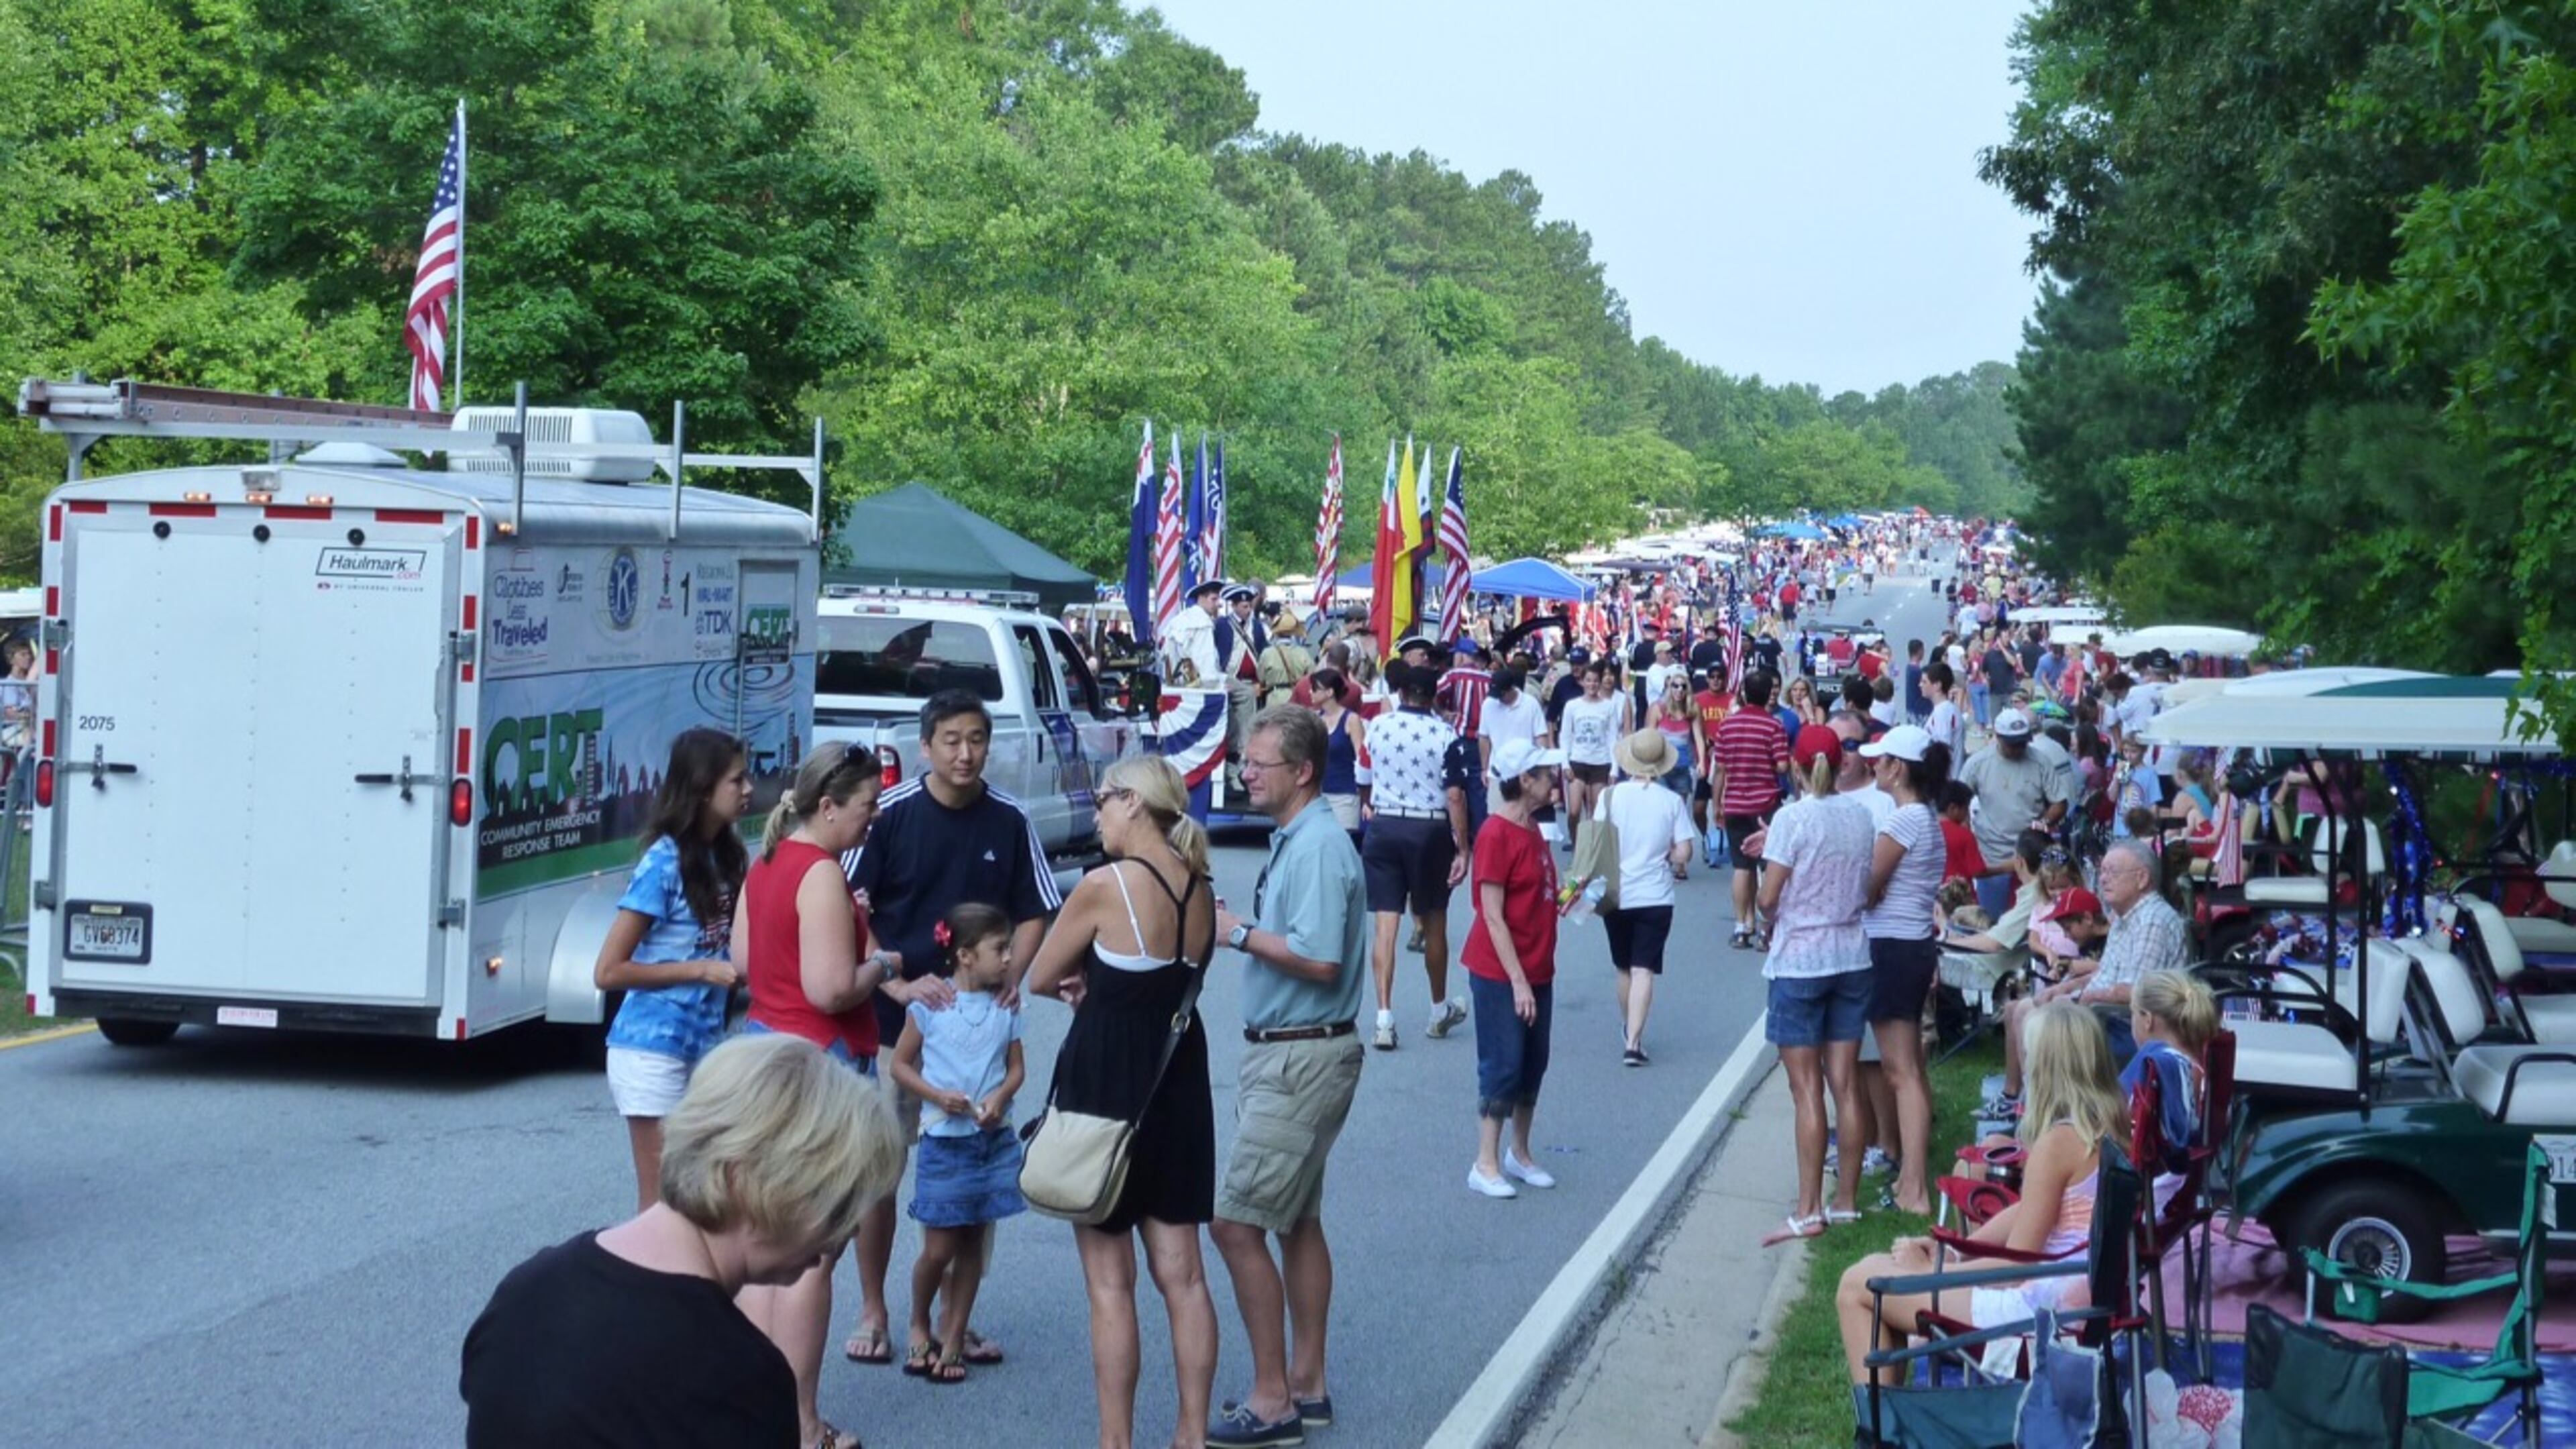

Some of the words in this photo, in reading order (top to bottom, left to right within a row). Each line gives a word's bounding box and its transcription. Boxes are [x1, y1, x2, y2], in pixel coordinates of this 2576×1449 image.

[329, 555, 408, 570] Haulmark
[494, 575, 544, 598] Clothes
[493, 616, 548, 647] Traveled
[704, 609, 733, 634] TDK
[79, 715, 115, 731] 2075
[484, 708, 602, 808] CERT
[480, 820, 542, 845] COMMUNITY
[545, 810, 601, 833] EMERGENCY
[502, 836, 551, 859] RESPONSE
[554, 830, 581, 850] TEAM
